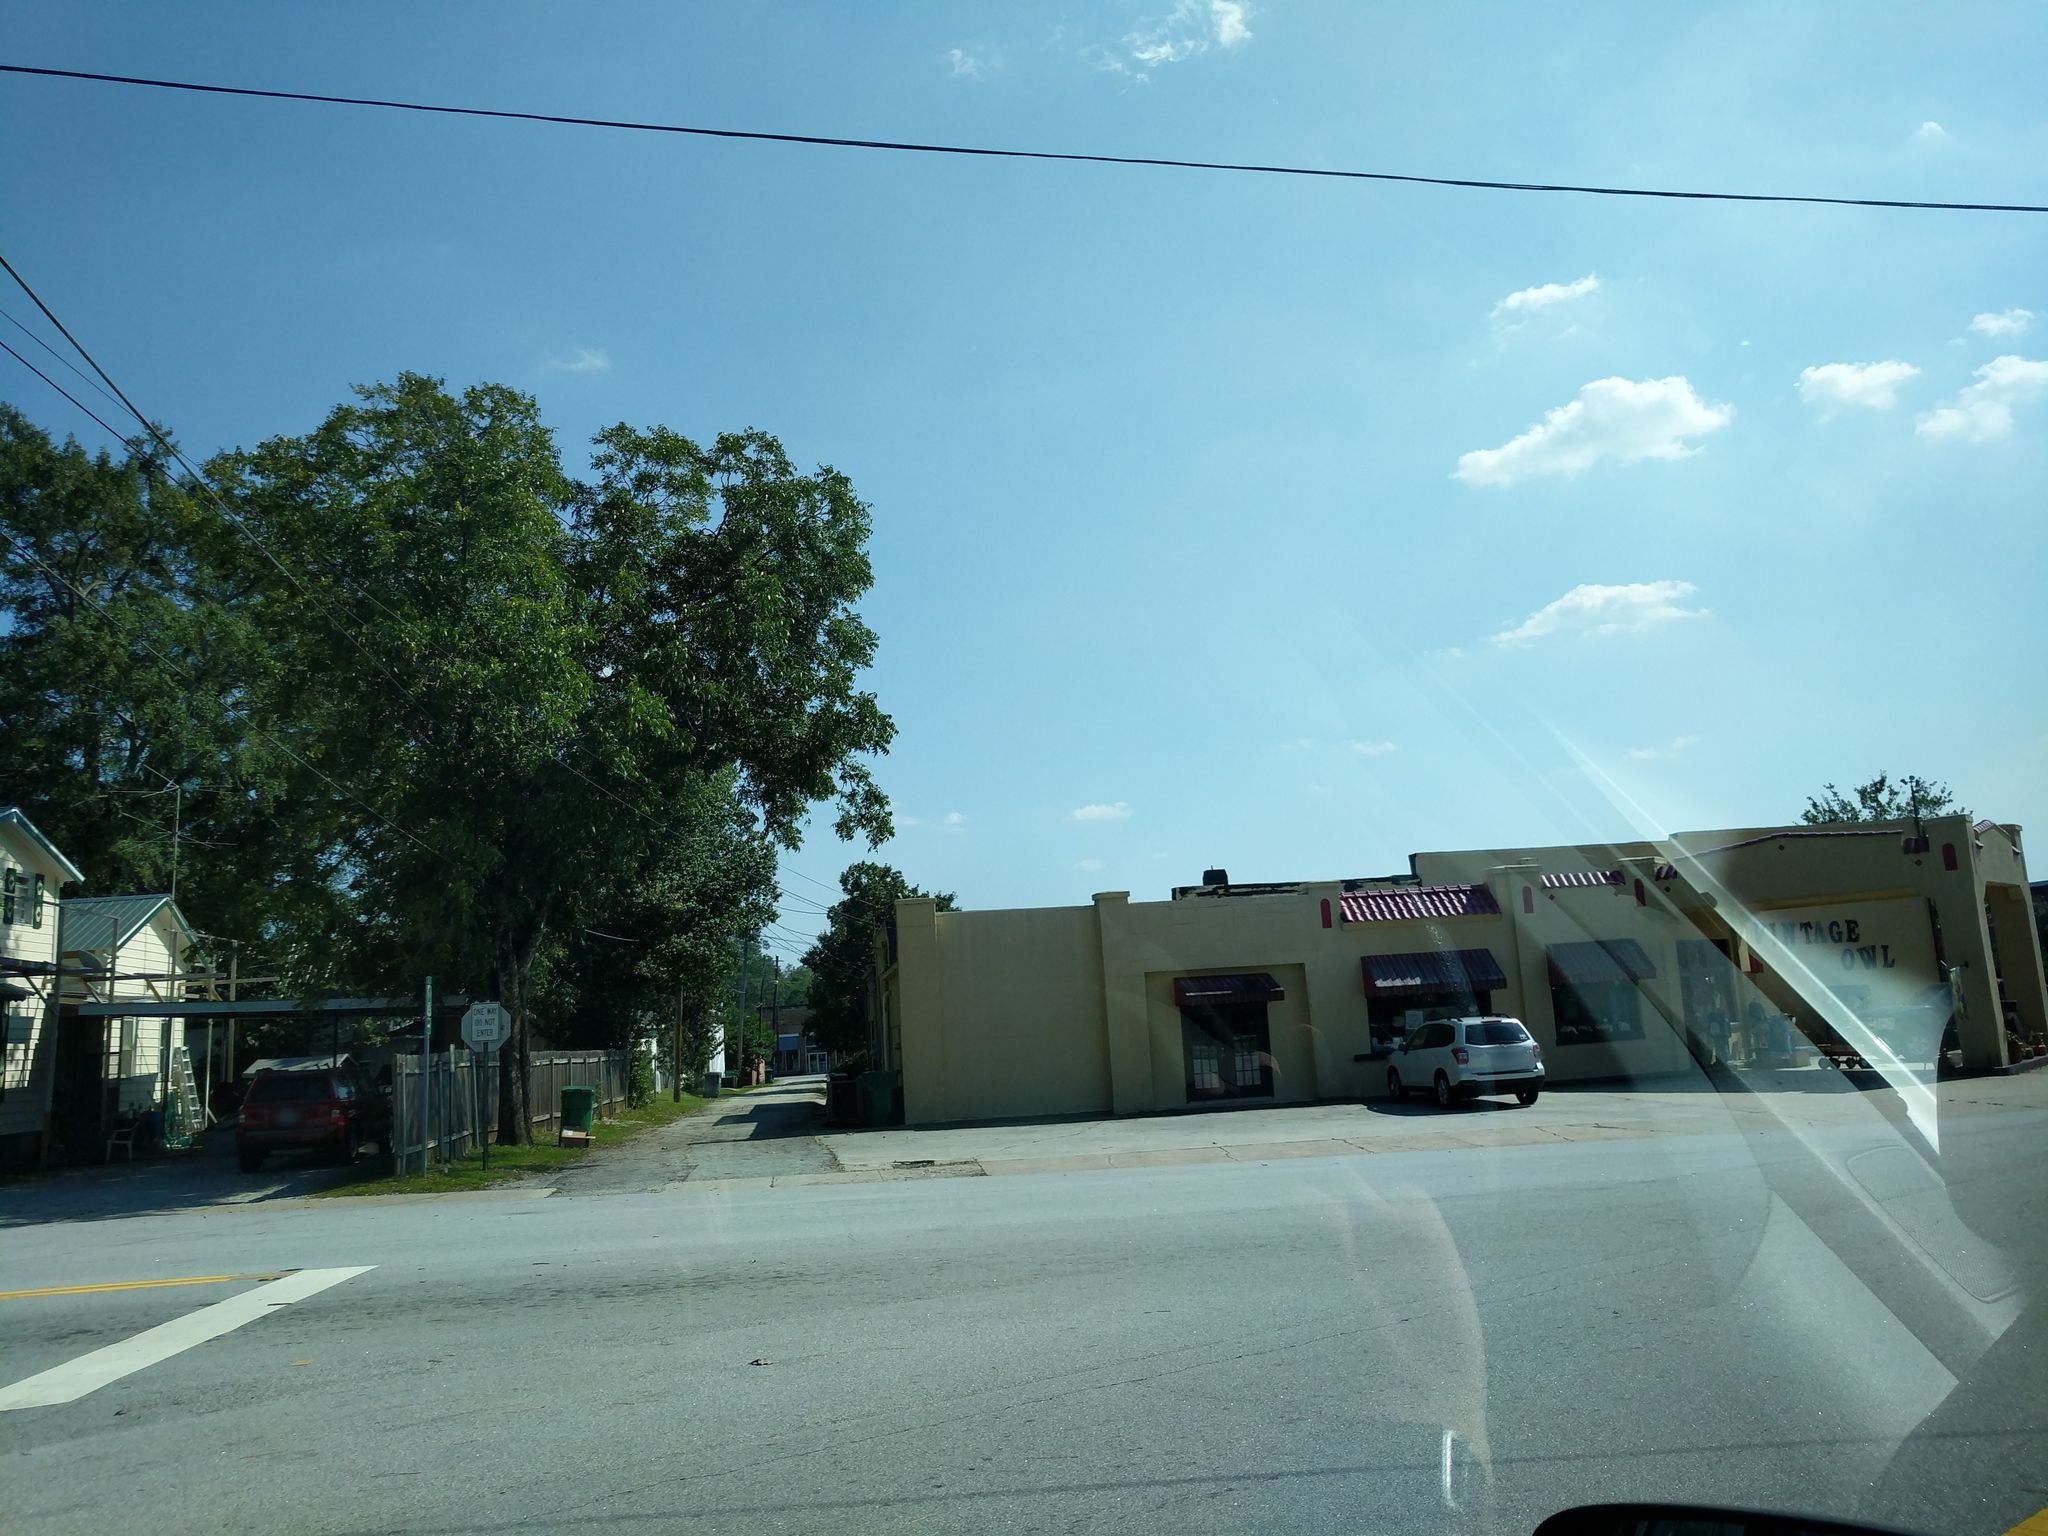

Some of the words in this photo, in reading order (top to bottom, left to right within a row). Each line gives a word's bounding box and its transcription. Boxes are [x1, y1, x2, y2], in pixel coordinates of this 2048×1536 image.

[1841, 945, 1895, 970] OWL
[473, 1007, 484, 1016] ONE
[487, 1007, 498, 1015] WAY
[485, 1018, 495, 1026] NOT
[476, 1029, 494, 1038] ENTER
